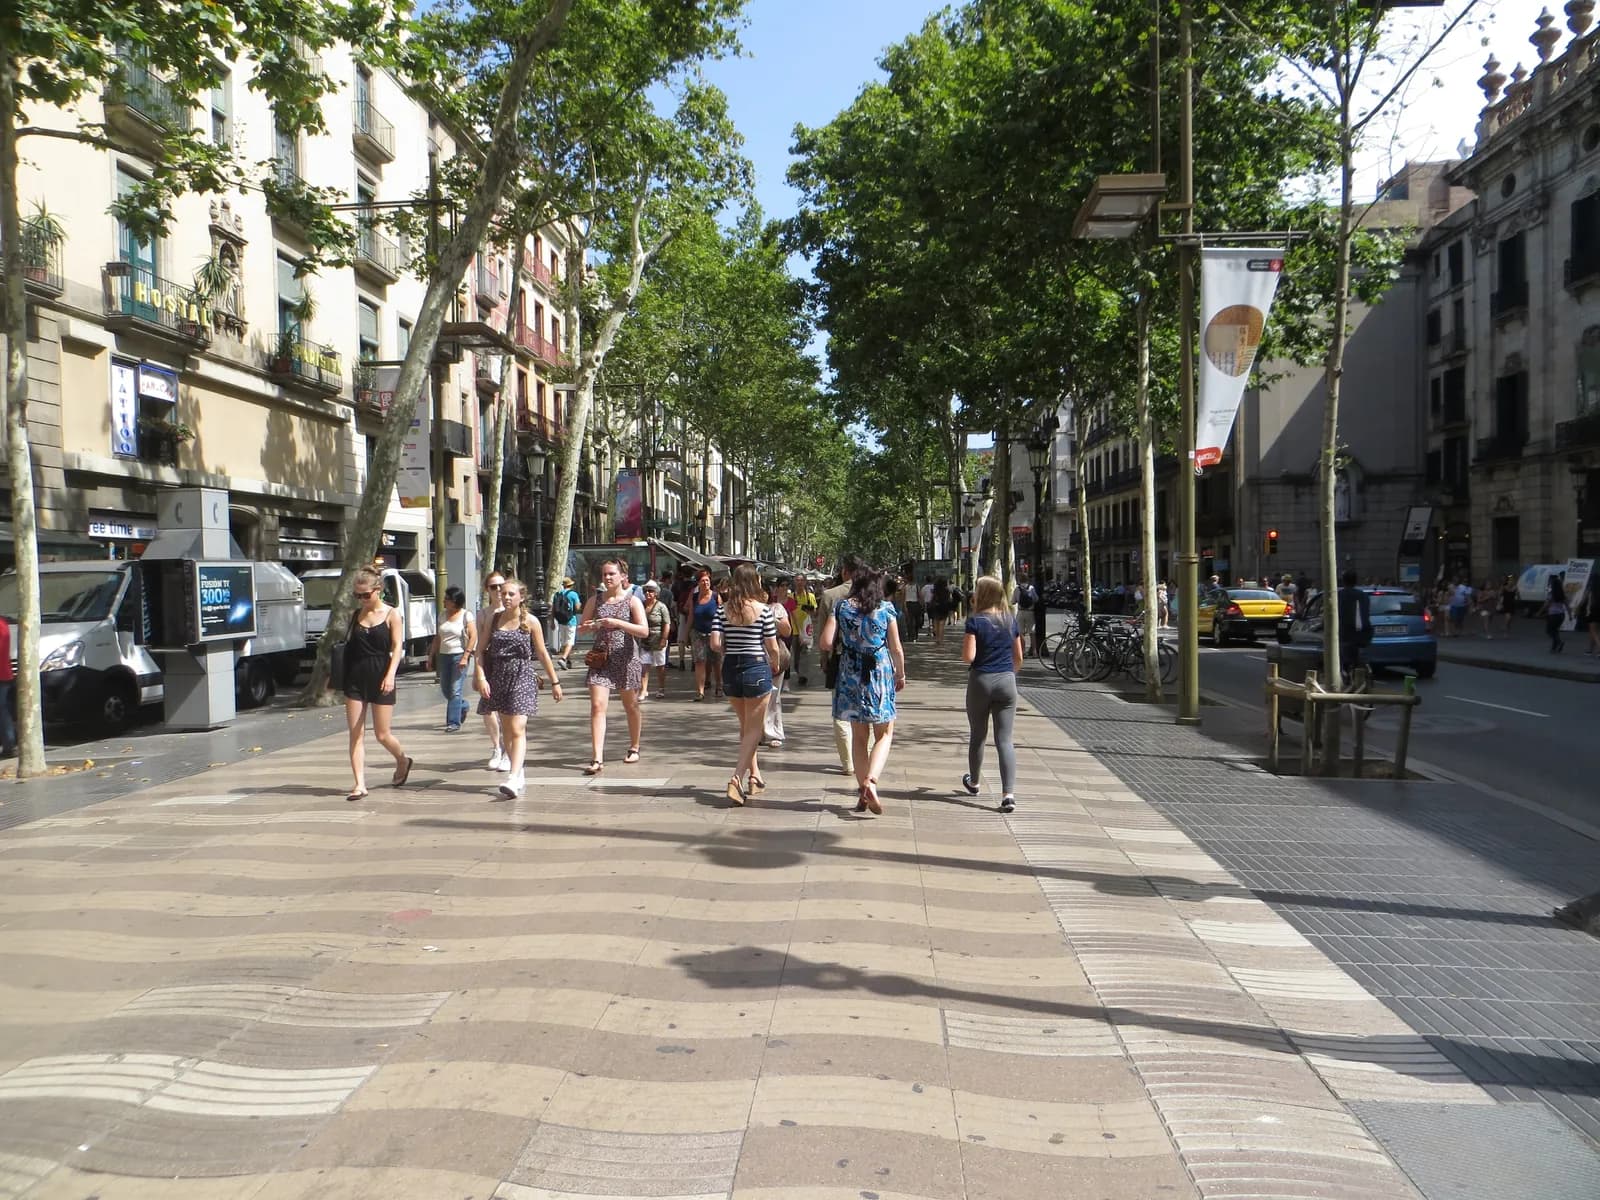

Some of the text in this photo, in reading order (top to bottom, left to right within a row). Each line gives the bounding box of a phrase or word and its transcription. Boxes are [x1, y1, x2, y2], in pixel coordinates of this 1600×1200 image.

[134, 281, 211, 327] HOSTAL
[117, 368, 132, 453] TATTOO
[109, 520, 133, 535] time
[201, 588, 223, 604] 300
